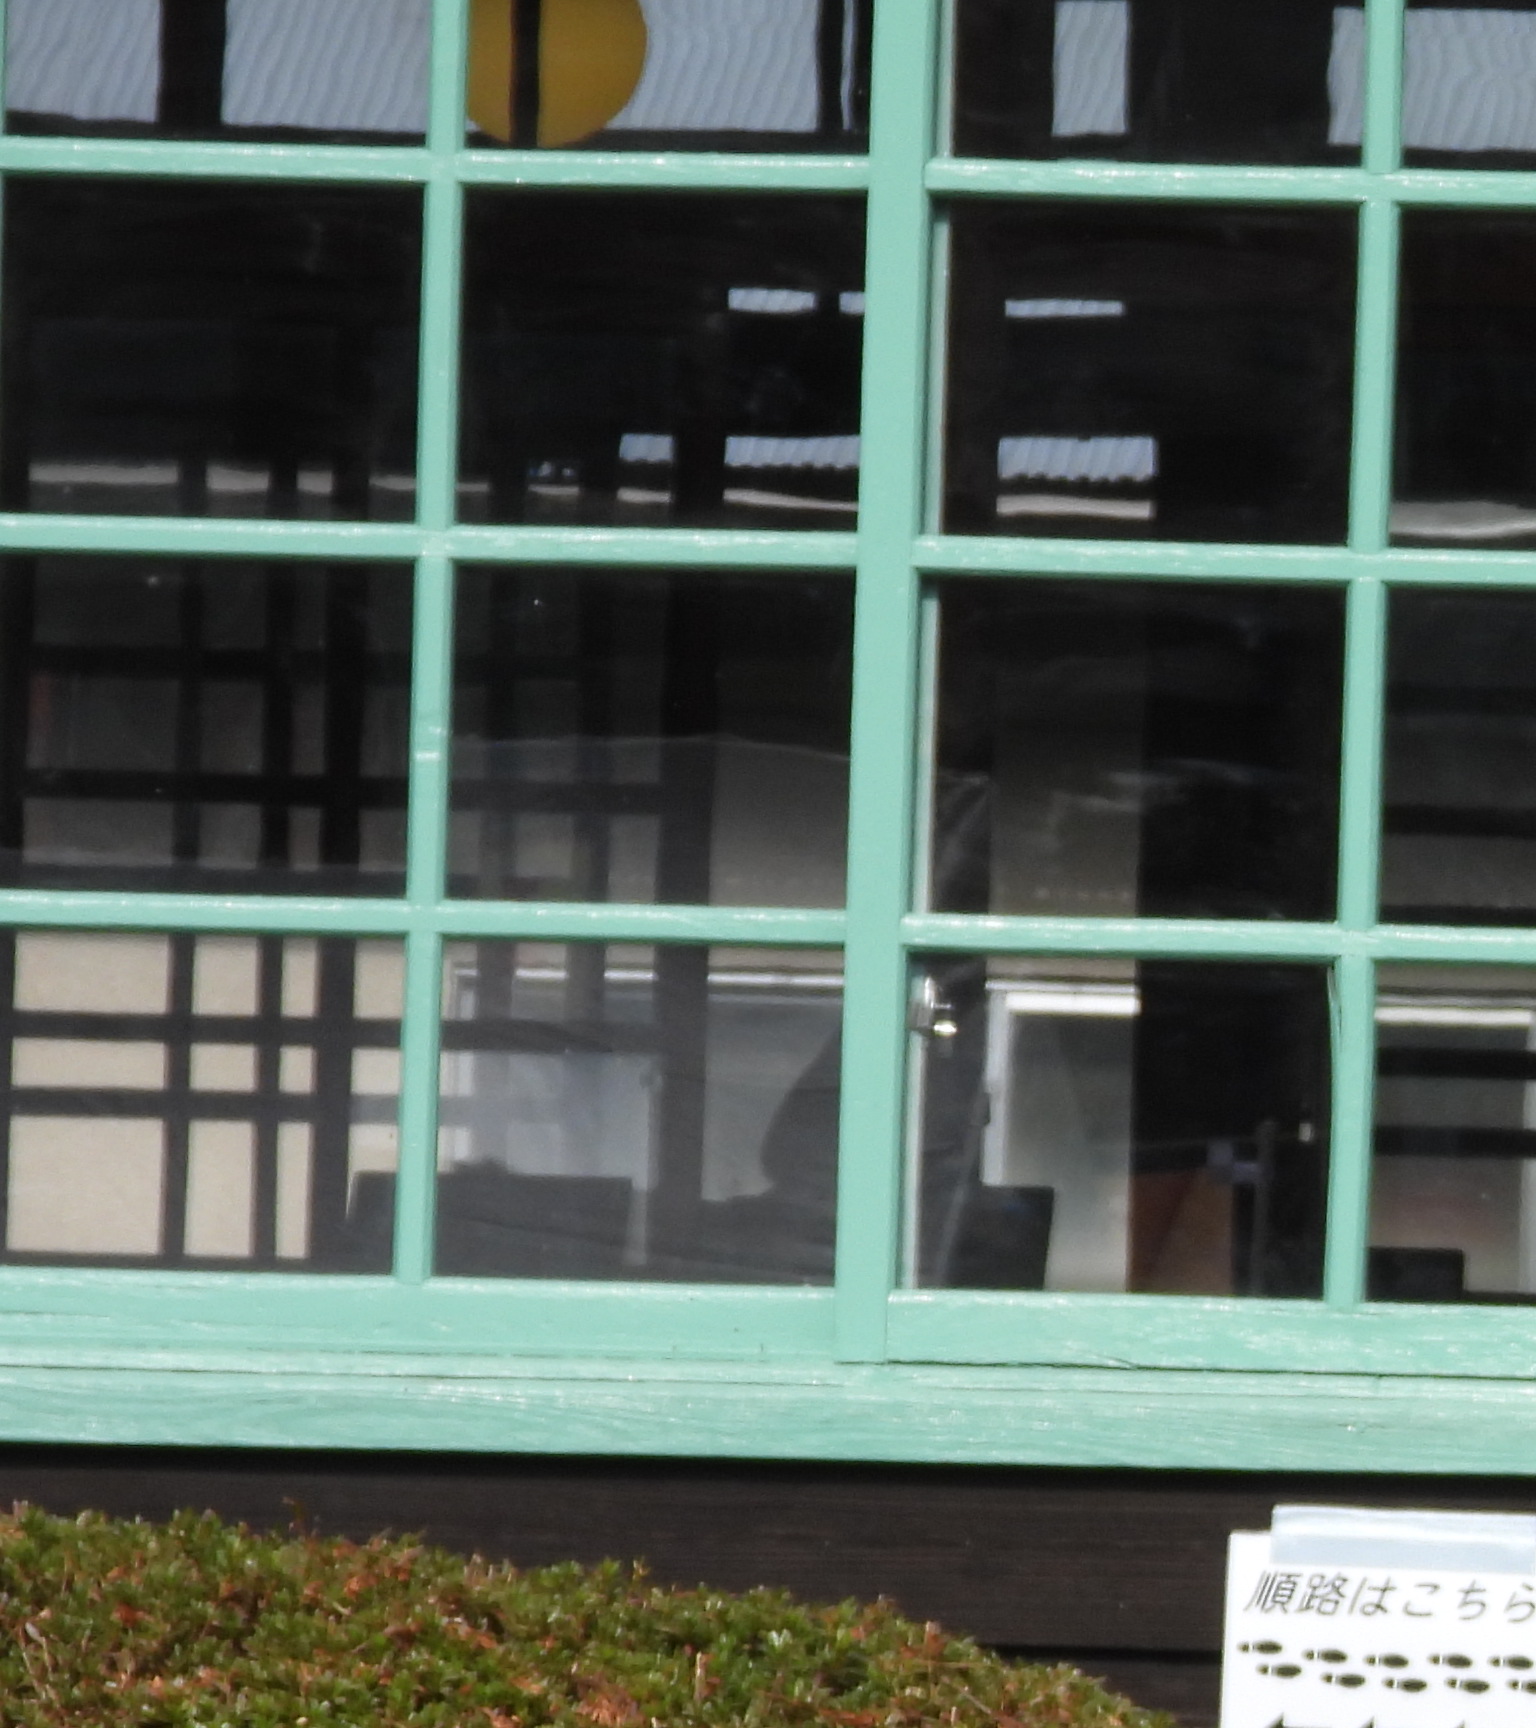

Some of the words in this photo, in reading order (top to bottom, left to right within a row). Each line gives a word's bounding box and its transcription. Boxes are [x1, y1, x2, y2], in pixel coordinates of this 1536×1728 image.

[1245, 1572, 1536, 1622] 順路はこちら
